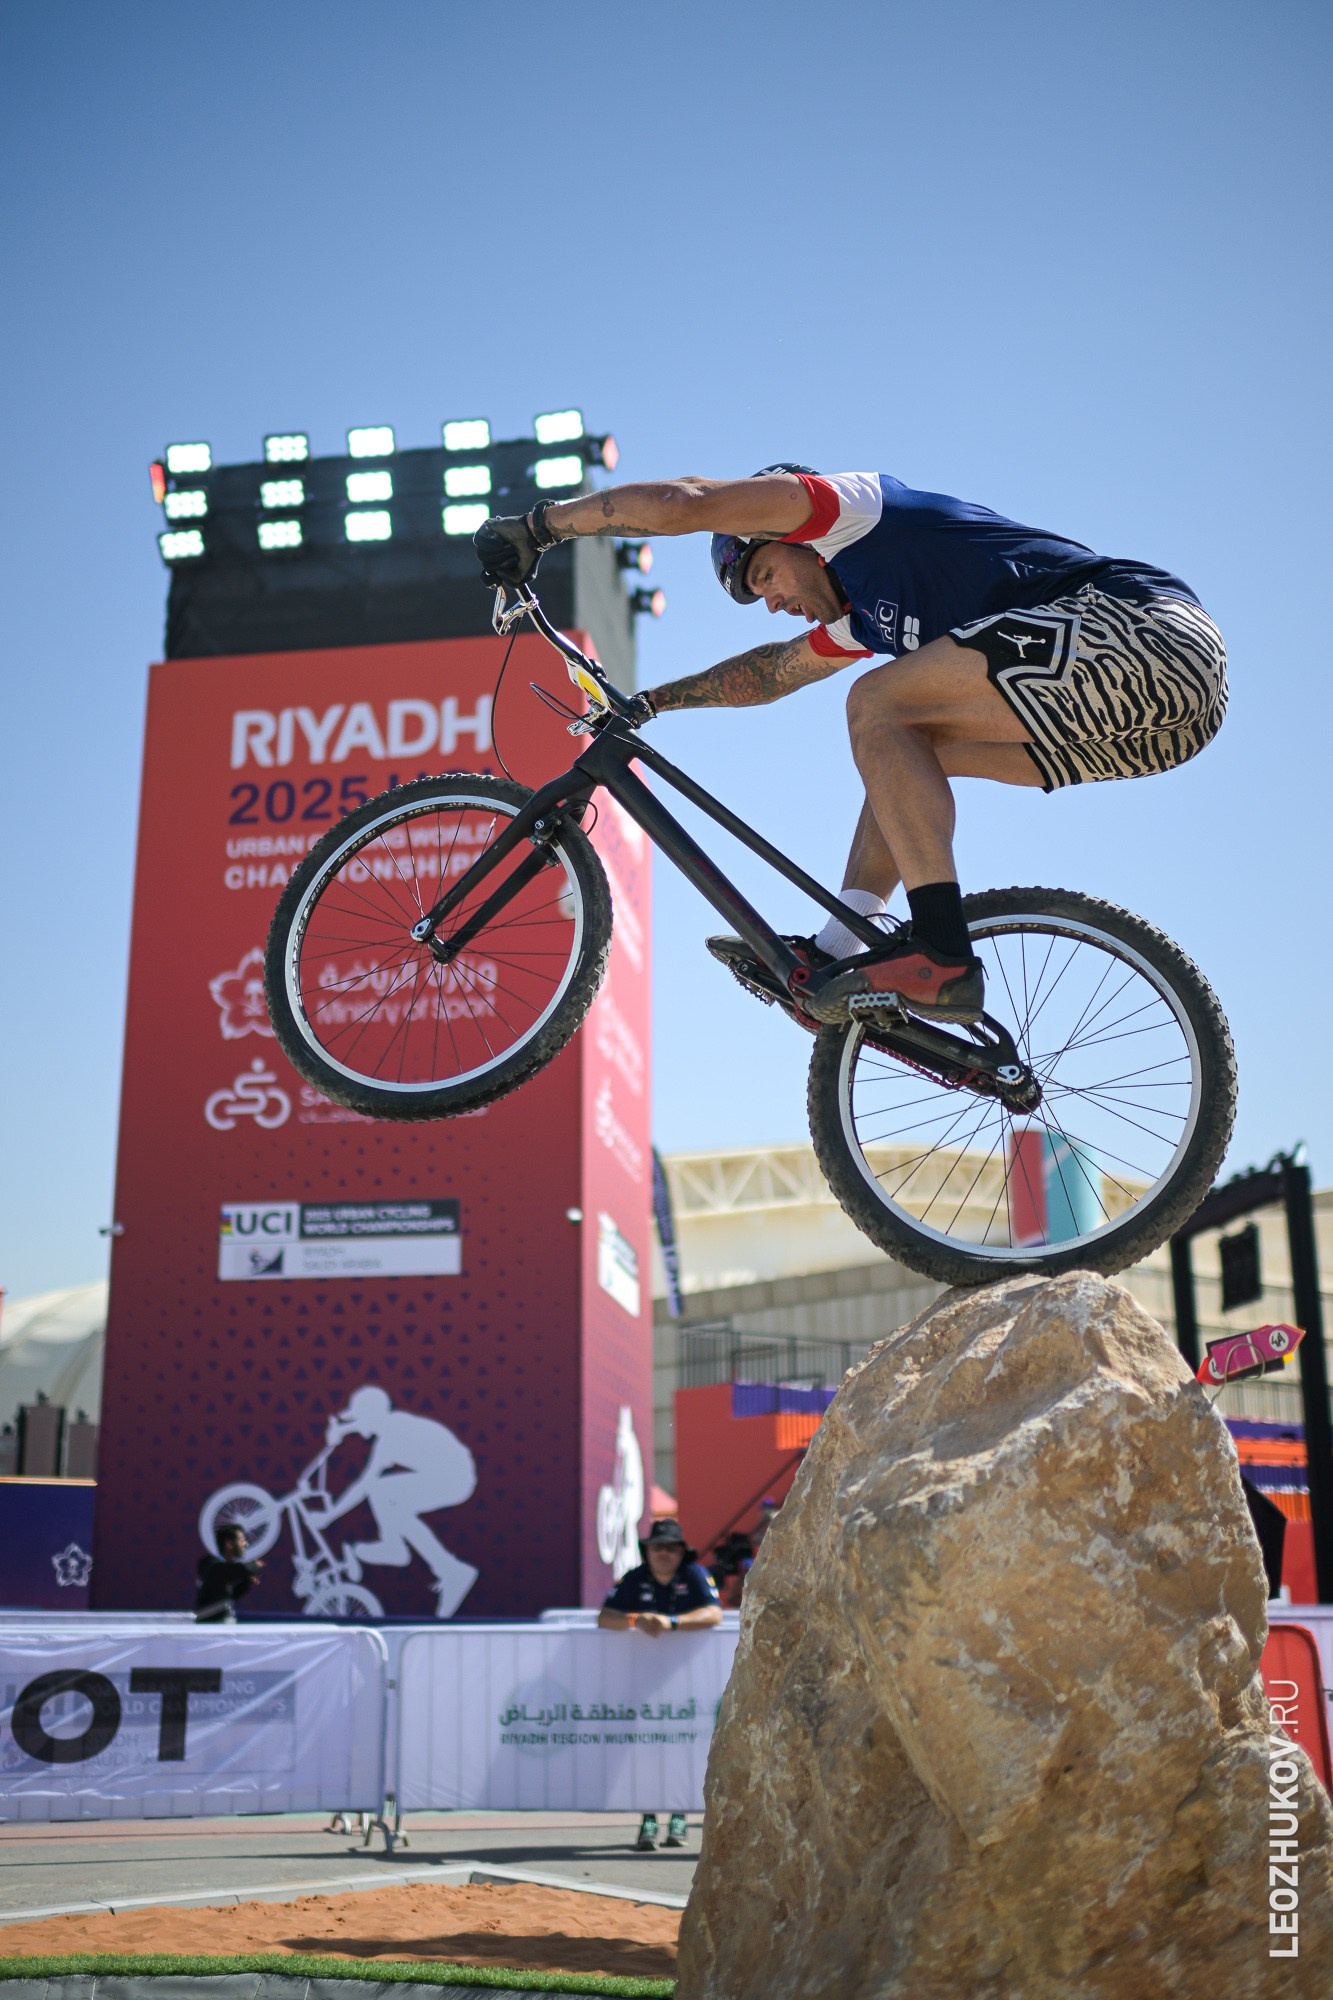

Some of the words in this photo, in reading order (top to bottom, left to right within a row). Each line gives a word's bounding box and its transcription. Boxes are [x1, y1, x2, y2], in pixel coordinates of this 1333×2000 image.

[230, 693, 493, 769] RIYADH
[229, 776, 368, 826] 2025
[226, 834, 305, 858] URBAN
[224, 851, 483, 890] CHAIONSHIP
[235, 1210, 292, 1235] UCI
[1271, 1332, 1286, 1348] 4A
[499, 1704, 567, 1726] الرياض
[571, 1704, 637, 1721] منطقة
[640, 1697, 696, 1720] أمانة
[500, 1733, 548, 1745] RIYADH
[552, 1733, 600, 1744] REGION
[603, 1732, 697, 1744] MUNICIPALITY
